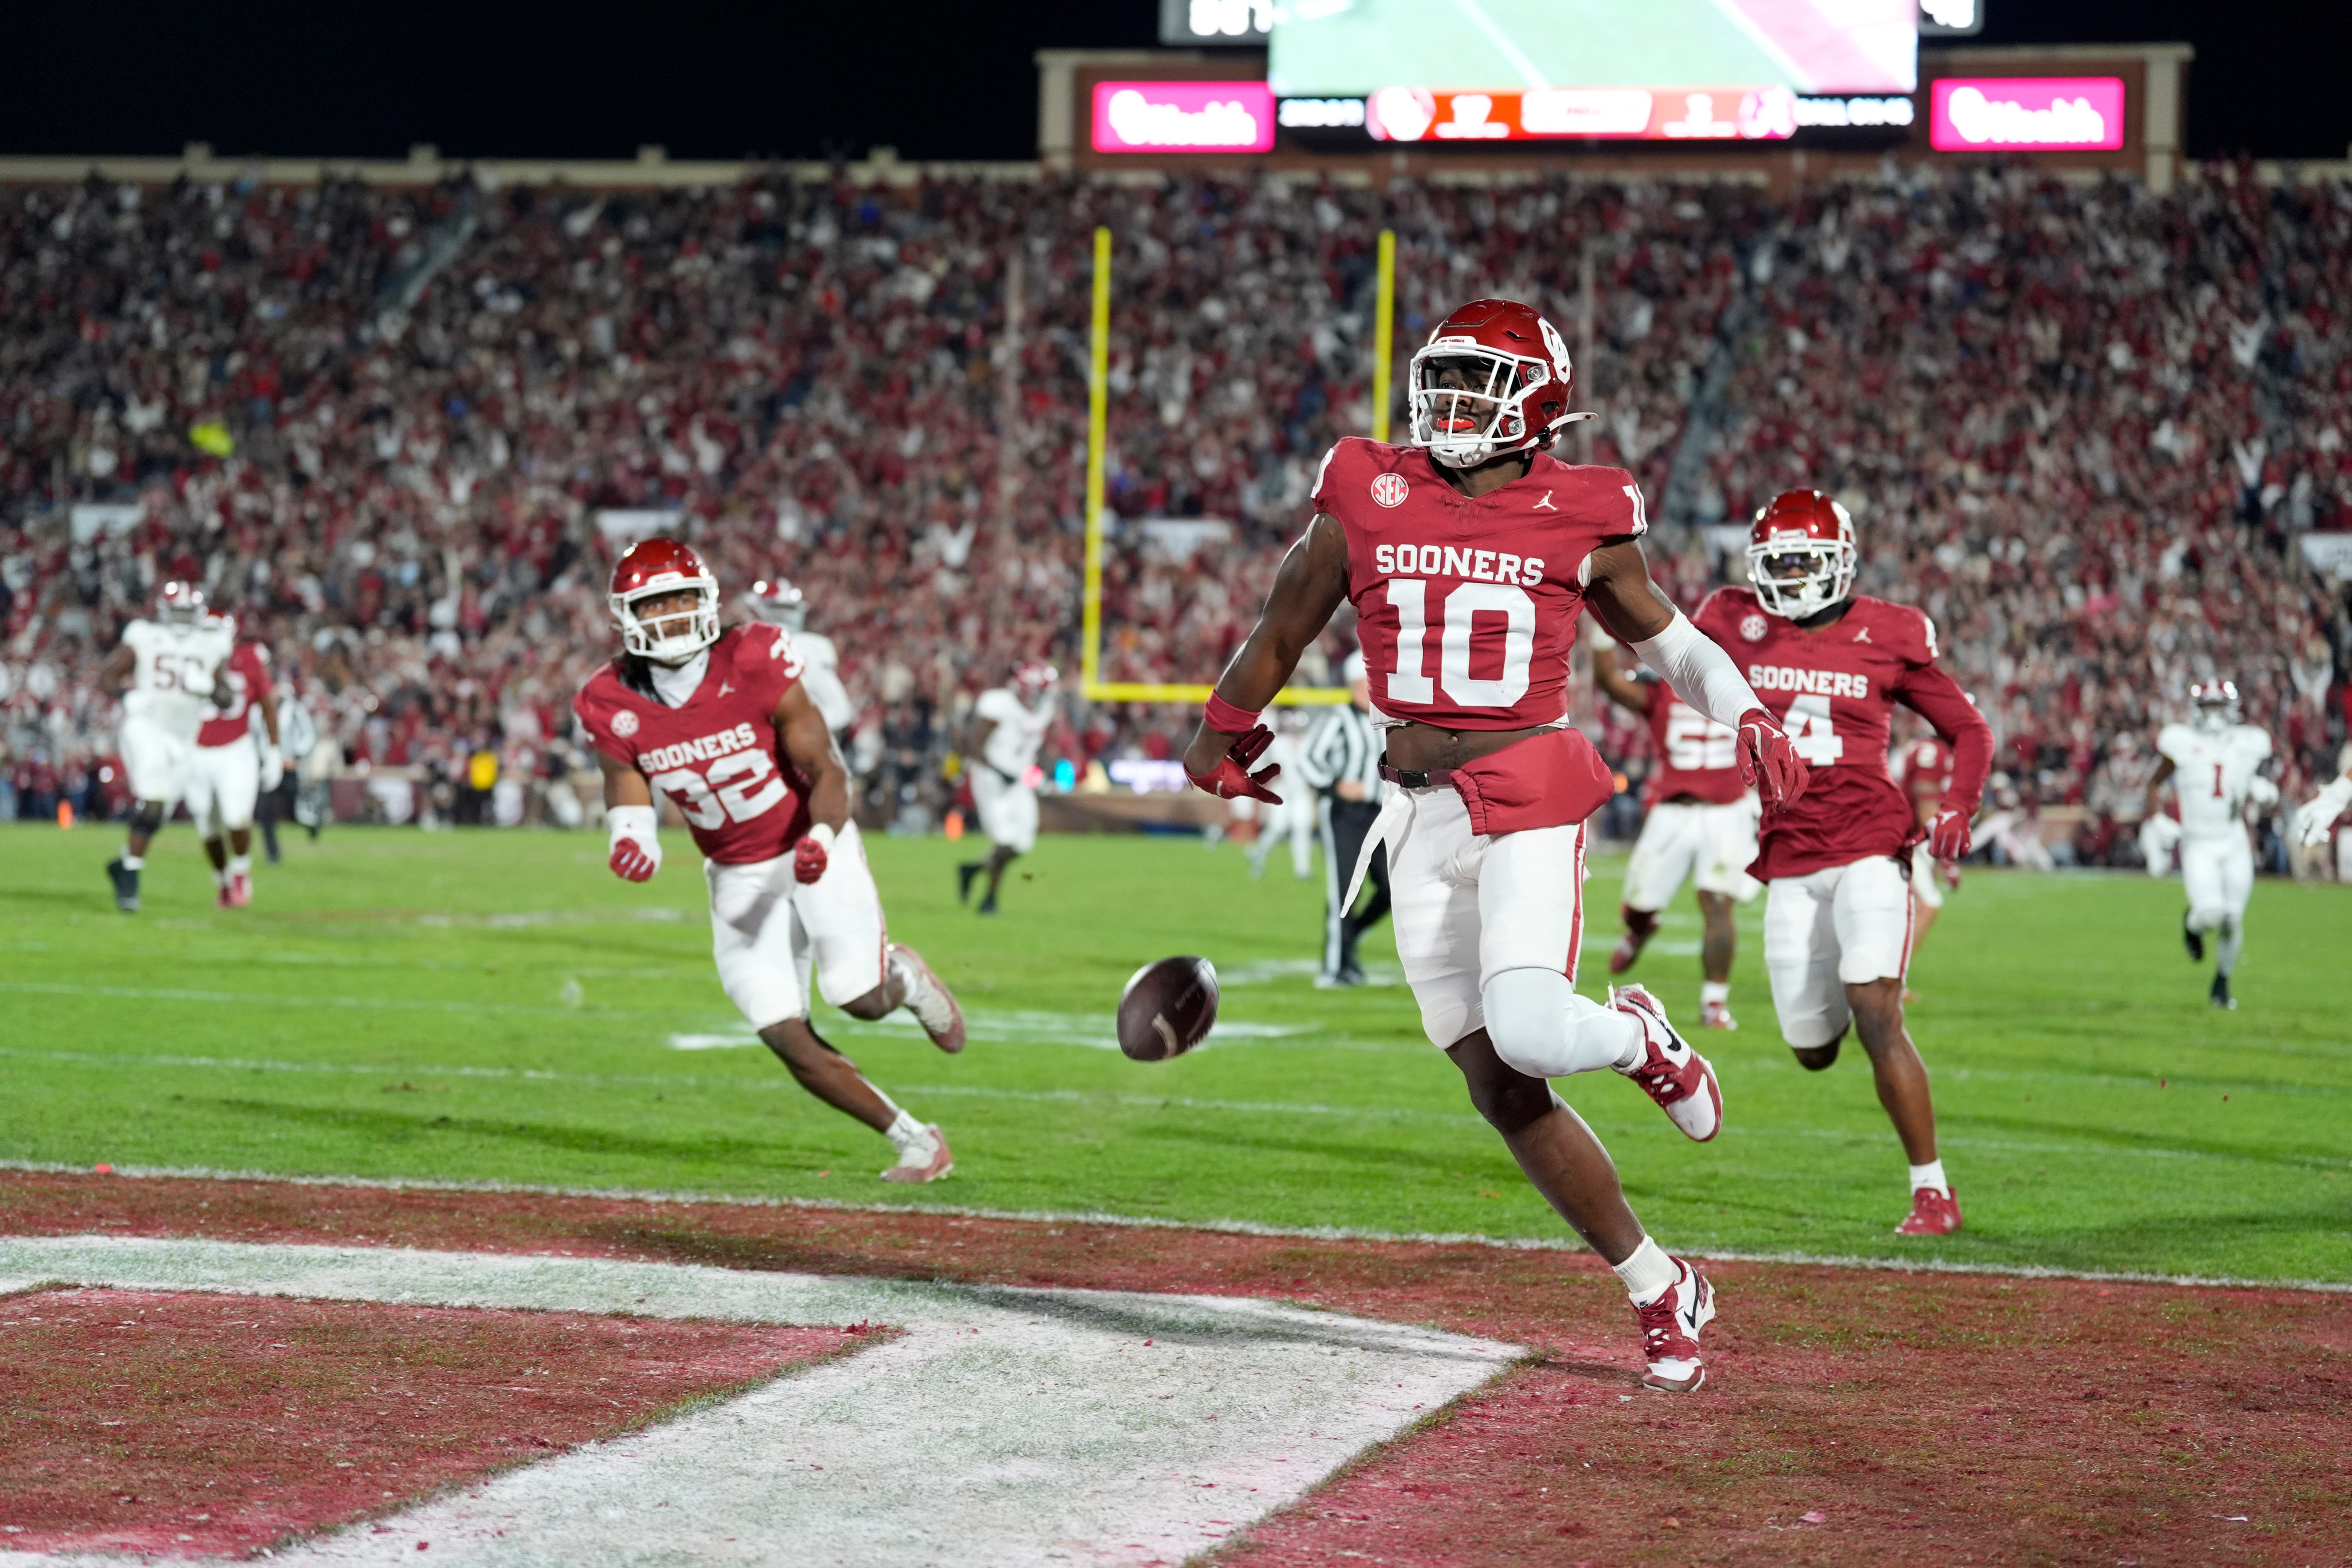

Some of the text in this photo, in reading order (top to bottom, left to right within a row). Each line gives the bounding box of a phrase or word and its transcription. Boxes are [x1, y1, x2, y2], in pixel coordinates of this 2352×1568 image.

[1374, 475, 1405, 506] SEC
[1376, 544, 1545, 586] SOONERS
[1386, 578, 1536, 707] 10
[1749, 664, 1868, 699] SOONERS
[638, 722, 756, 773] SOONERS
[1781, 694, 1843, 766] 4
[650, 747, 789, 830] 32
[2212, 764, 2224, 798] 1
